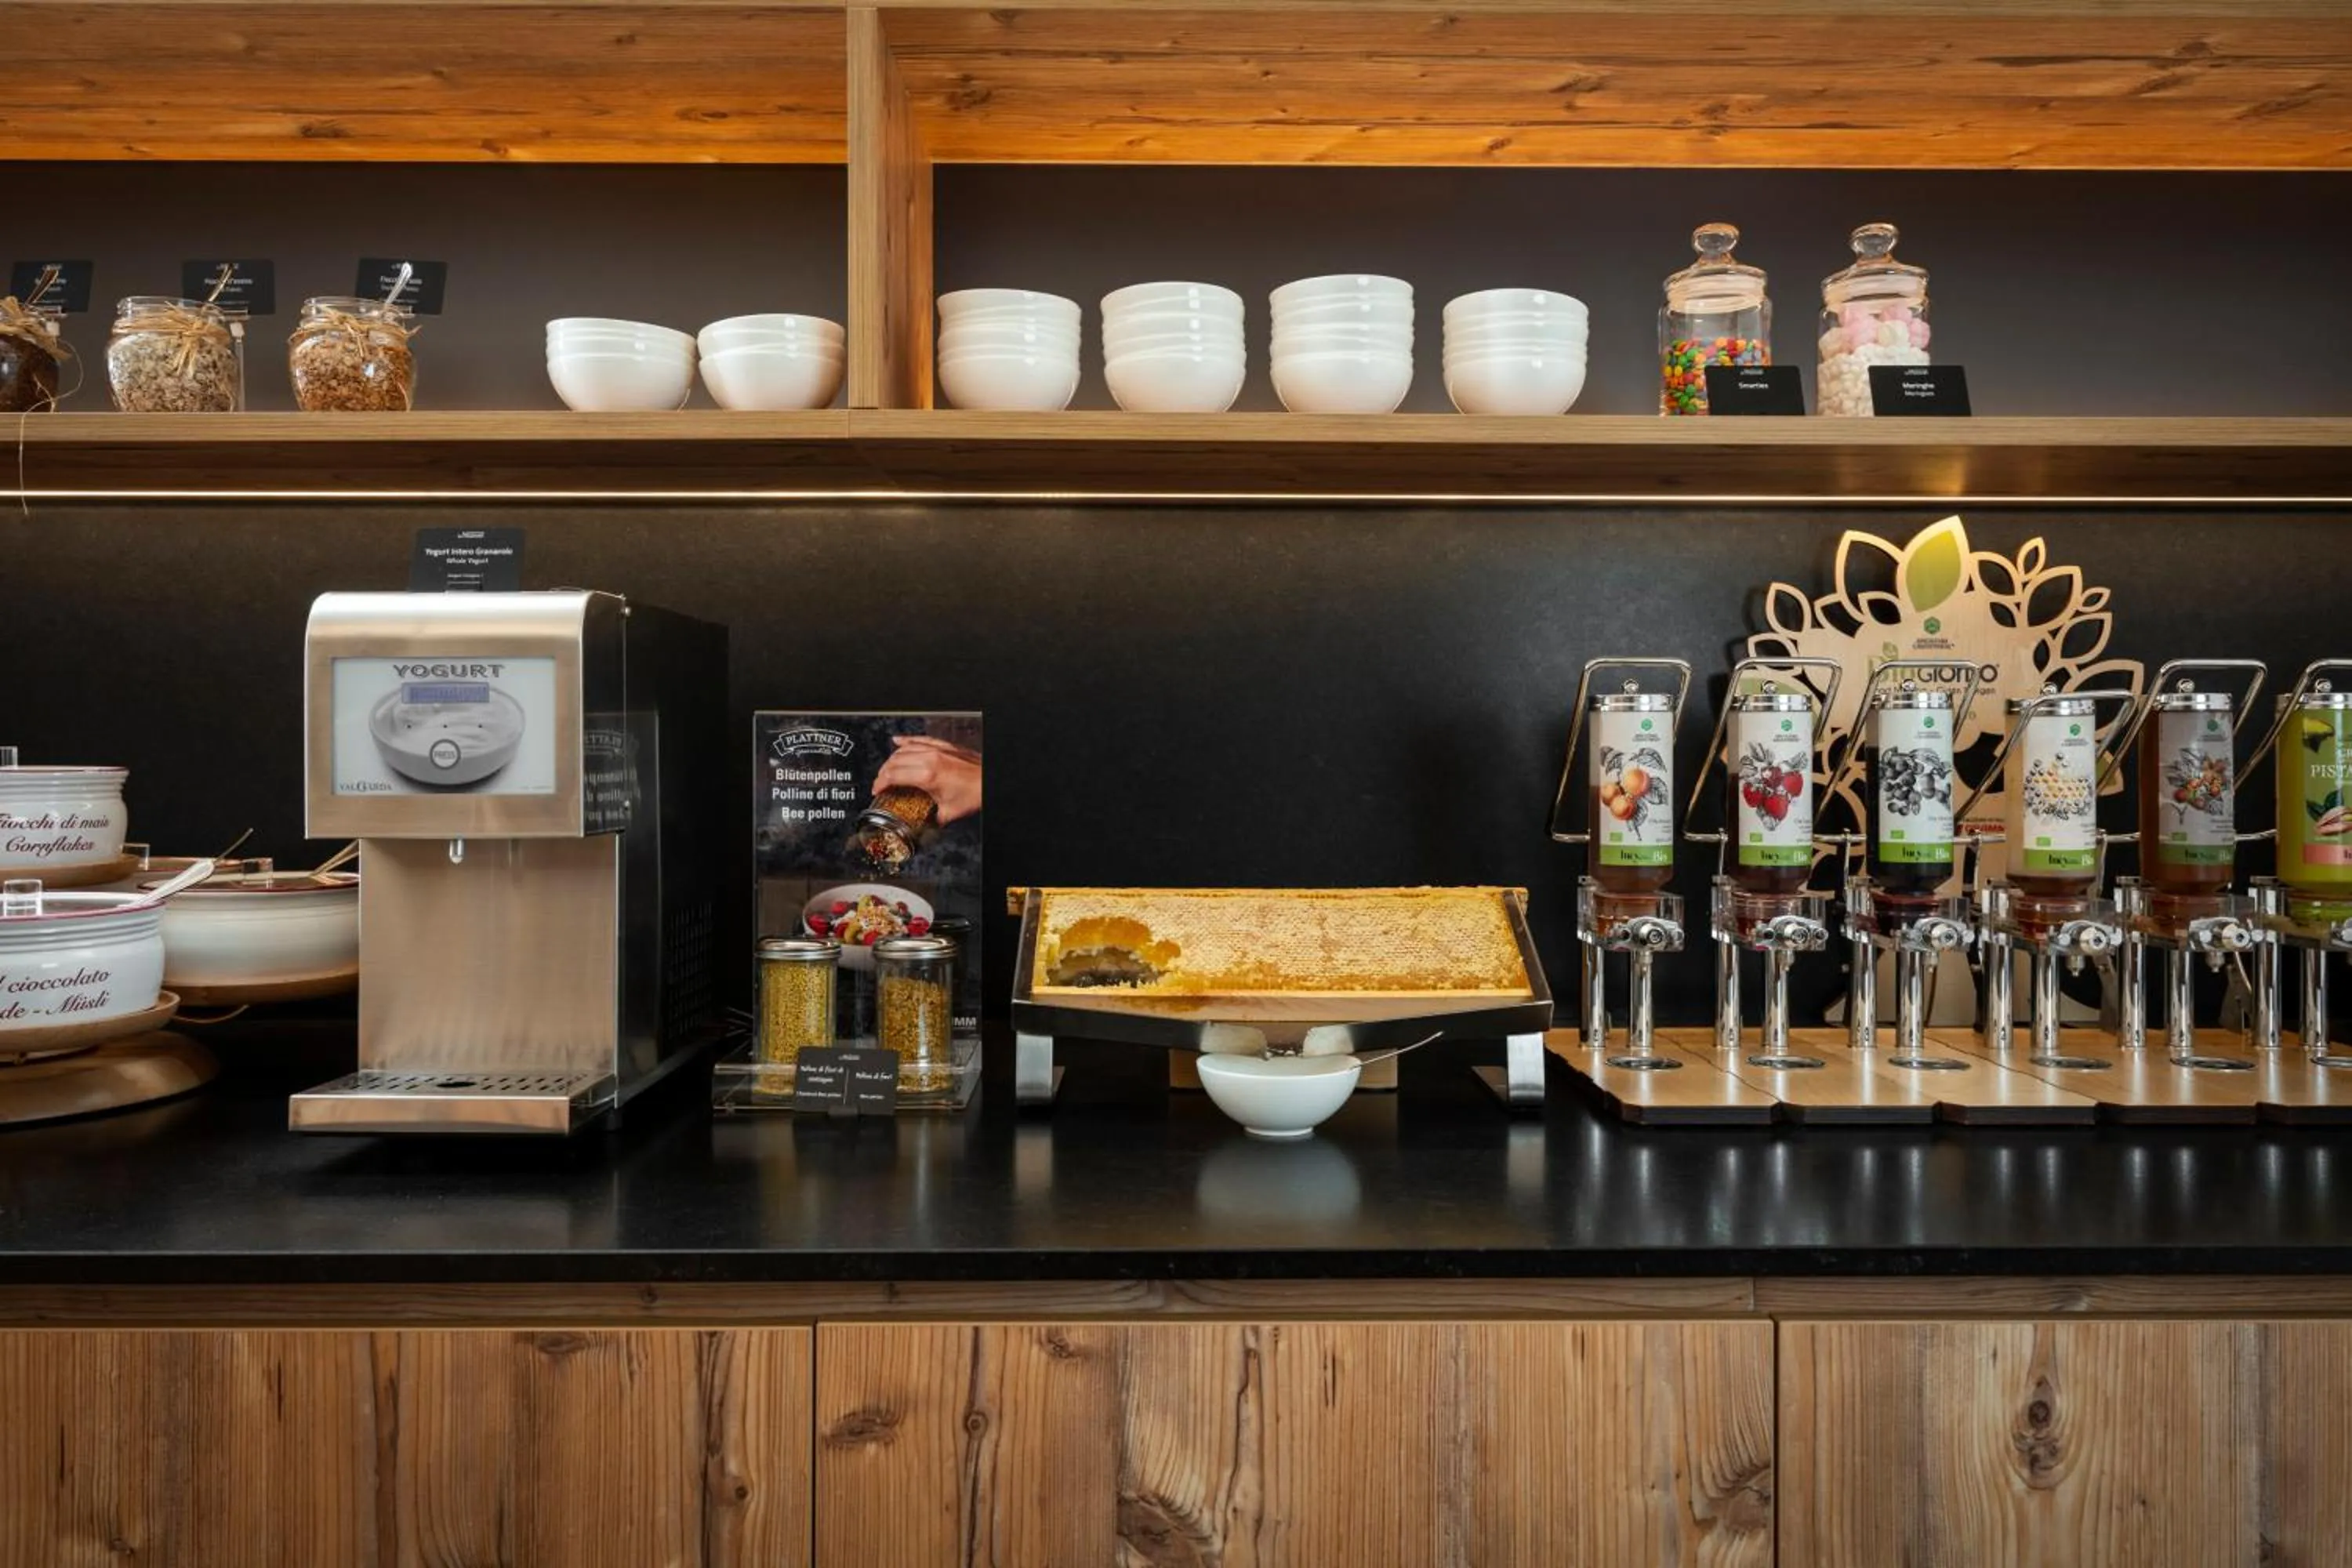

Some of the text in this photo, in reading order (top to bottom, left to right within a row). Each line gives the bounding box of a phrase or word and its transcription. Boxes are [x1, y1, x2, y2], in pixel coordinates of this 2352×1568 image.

[426, 548, 449, 557] Yogurt
[393, 664, 506, 678] YOGURT
[786, 733, 842, 746] PLATTNER
[775, 768, 851, 784] Blütenpollen
[771, 787, 855, 800] Polline di fiori
[60, 813, 78, 829] di
[782, 807, 846, 822] Bee pollen
[8, 967, 111, 993] cioccolato
[45, 989, 110, 1015] Müsli
[952, 1017, 976, 1026] MM
